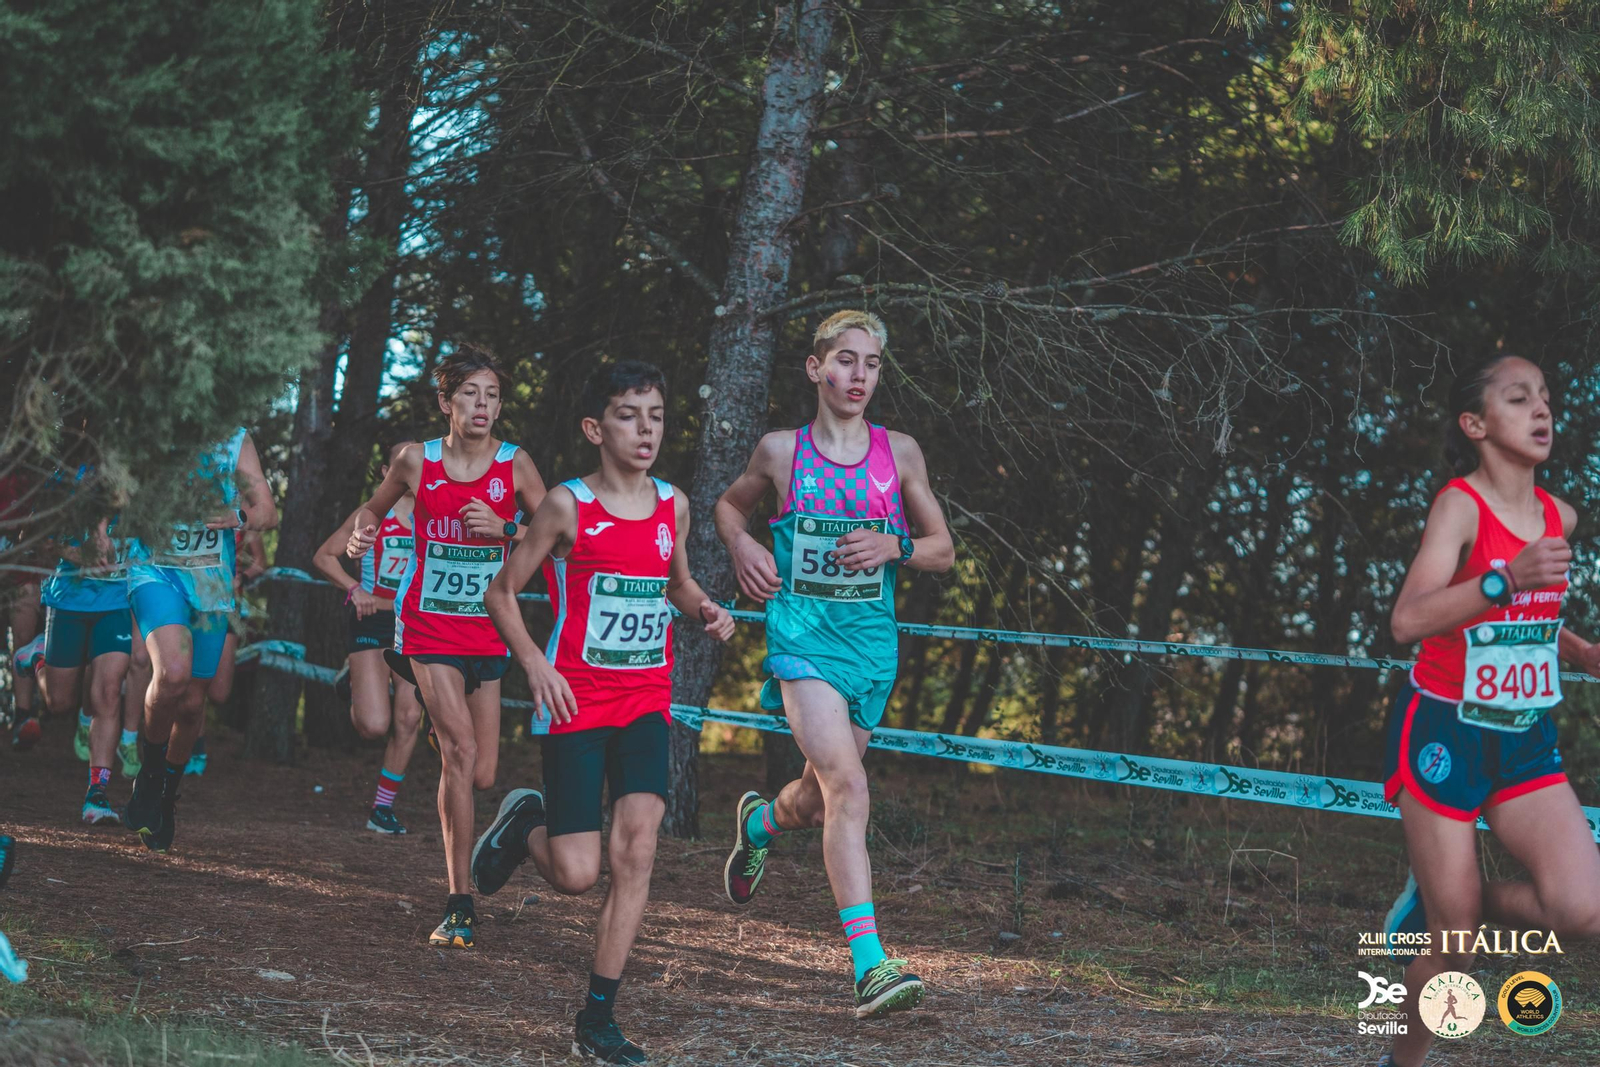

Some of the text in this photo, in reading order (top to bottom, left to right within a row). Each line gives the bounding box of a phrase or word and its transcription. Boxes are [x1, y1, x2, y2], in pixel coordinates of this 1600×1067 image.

[176, 529, 218, 551] 979
[448, 547, 485, 558] ITÁLICA
[600, 610, 667, 642] 7955
[1476, 661, 1554, 700] 8401
[967, 748, 995, 760] Sevilla
[1056, 761, 1087, 773] Sevilla
[1151, 773, 1184, 786] Sevilla
[1253, 786, 1287, 799] Sevilla
[1361, 799, 1396, 813] Sevilla
